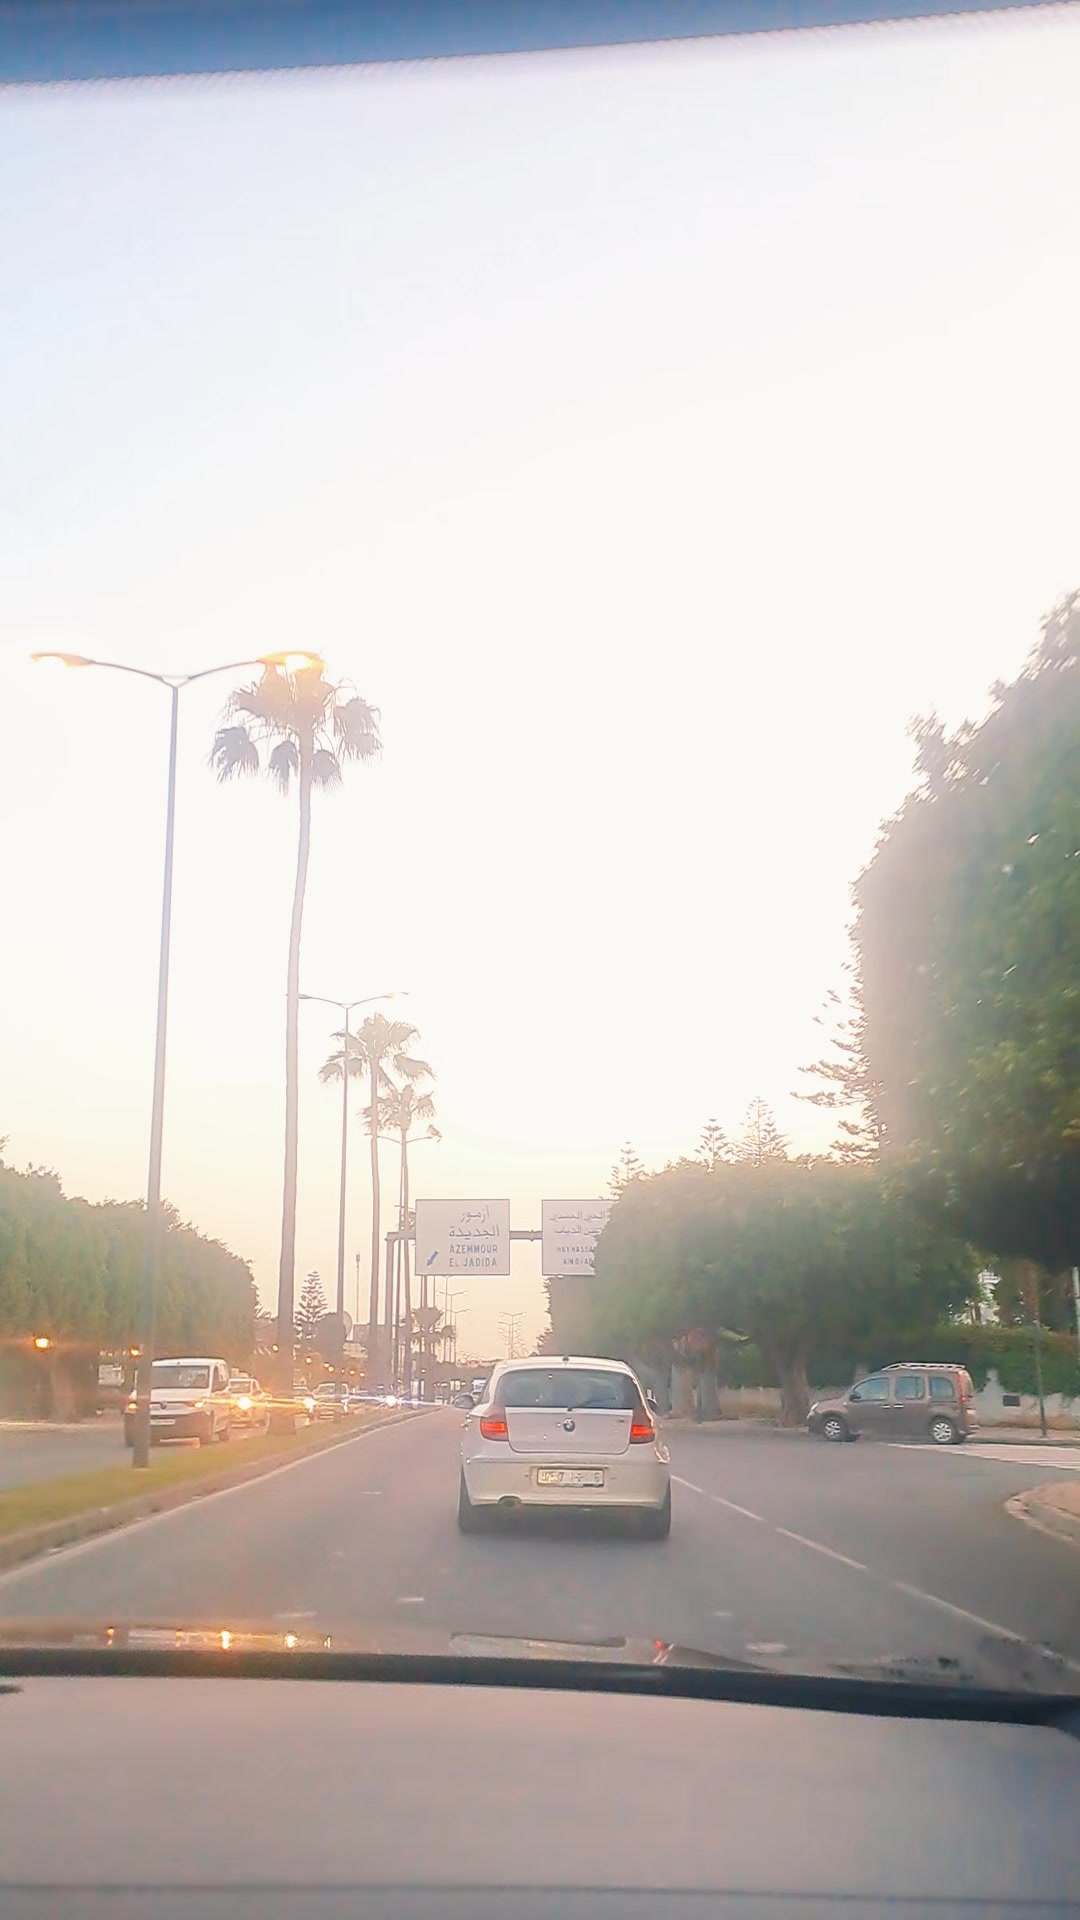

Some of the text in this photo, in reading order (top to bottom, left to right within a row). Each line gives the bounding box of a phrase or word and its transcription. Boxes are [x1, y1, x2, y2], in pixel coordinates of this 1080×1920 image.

[449, 1224, 500, 1240] الجديدة
[449, 1244, 498, 1254] AZEMMOUR
[449, 1257, 497, 1267] EL JADIDA
